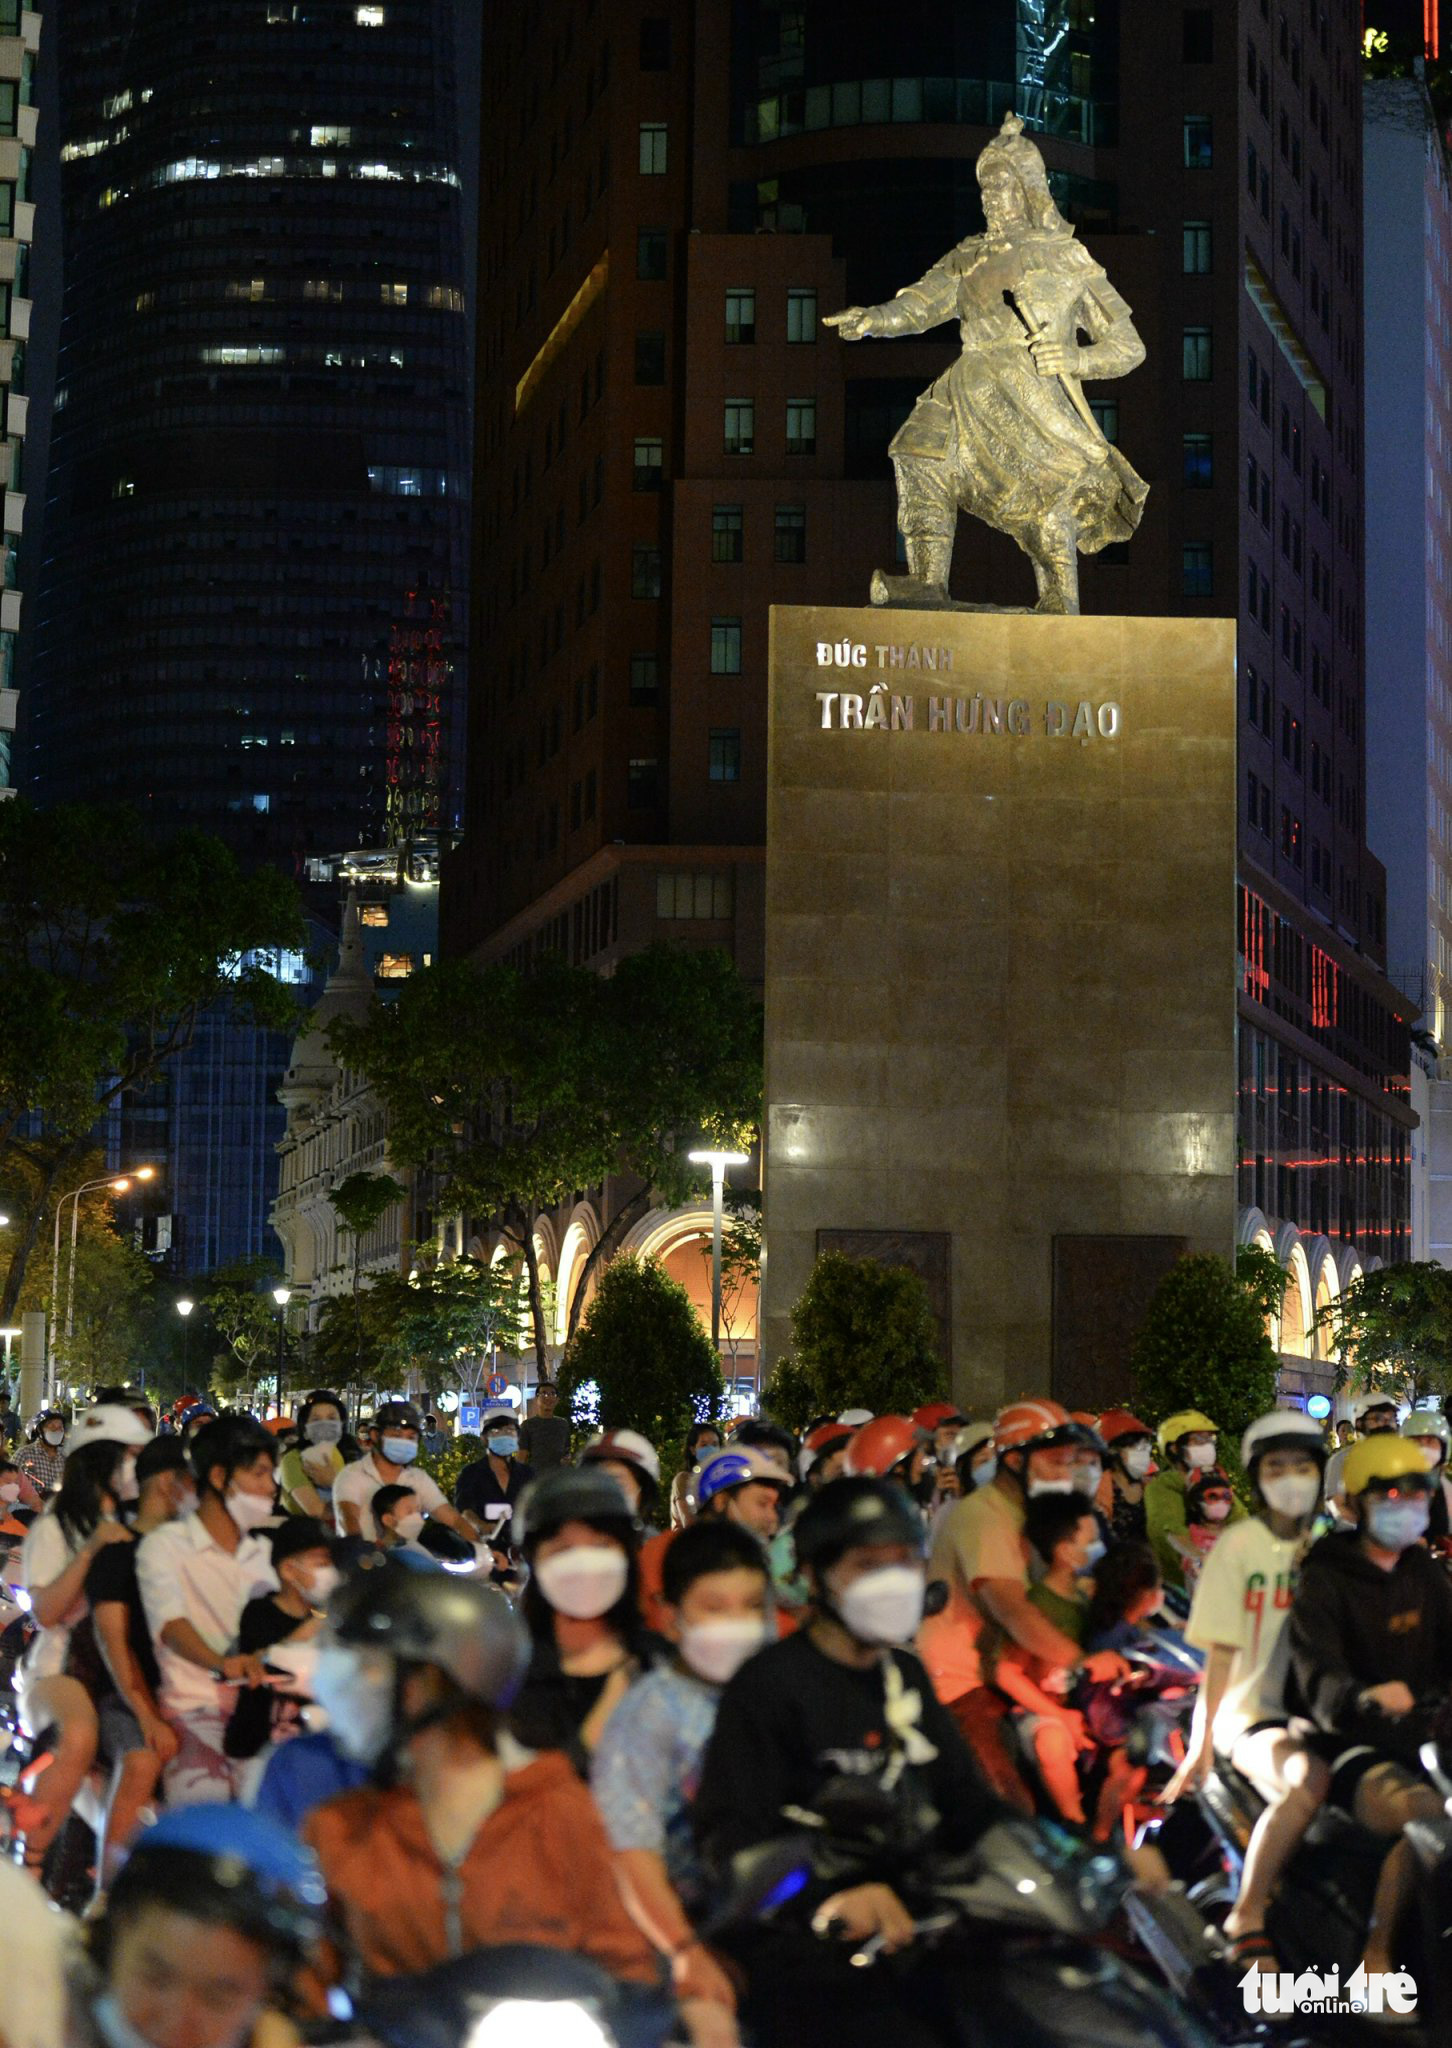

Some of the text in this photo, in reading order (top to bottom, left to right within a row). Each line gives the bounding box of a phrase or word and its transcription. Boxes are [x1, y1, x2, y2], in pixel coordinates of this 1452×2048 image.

[816, 638, 866, 668] ĐỨC
[815, 682, 1122, 747] TRẦN HƯNG ĐẠO
[467, 1411, 476, 1422] P
